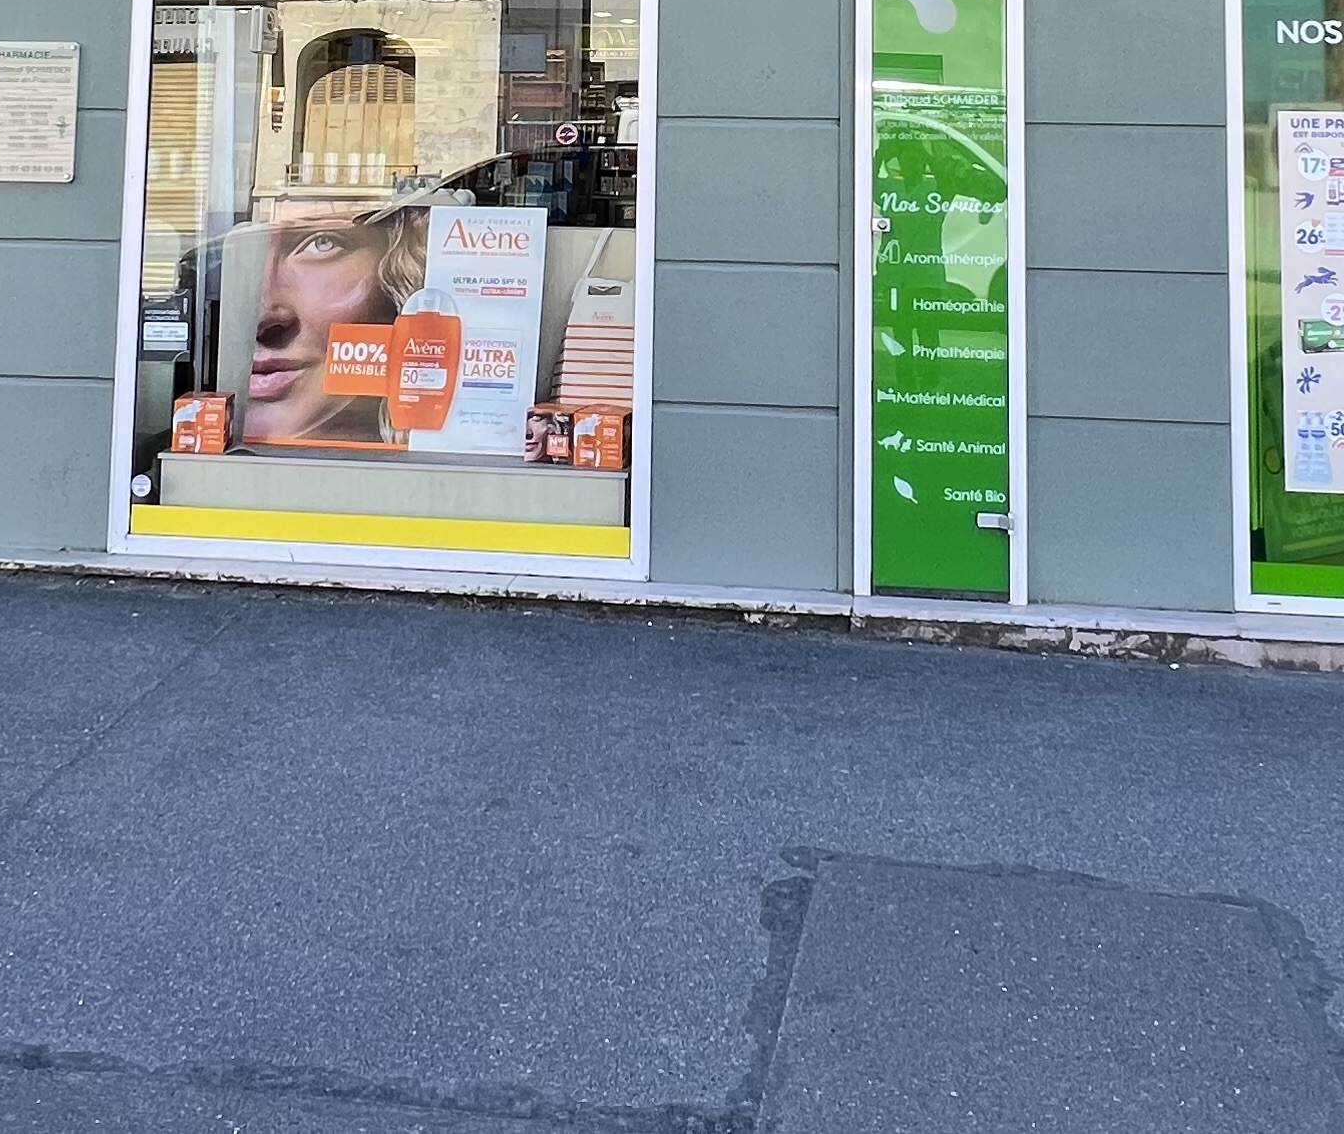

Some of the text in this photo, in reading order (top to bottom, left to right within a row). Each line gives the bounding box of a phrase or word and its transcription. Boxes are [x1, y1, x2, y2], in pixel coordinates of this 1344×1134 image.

[1276, 20, 1343, 44] NOS
[933, 95, 999, 105] SCHMEDER
[1290, 118, 1320, 129] UNE
[880, 192, 1003, 215] Nos Services
[443, 218, 530, 250] Avène
[903, 252, 1005, 268] Aromathérapie
[913, 298, 1005, 314] Homéopathie
[331, 341, 388, 363] 100%
[403, 338, 446, 356] Avène
[464, 340, 518, 349] PROTECTION
[464, 349, 516, 363] ULTRA
[912, 345, 1005, 362] Phytothérapie
[329, 363, 388, 377] INVISIBLE
[463, 364, 515, 378] LARGE
[897, 391, 1006, 407] Matériel Médical
[916, 439, 1006, 455] Santé Animal
[944, 487, 1006, 503] Santé Bio
